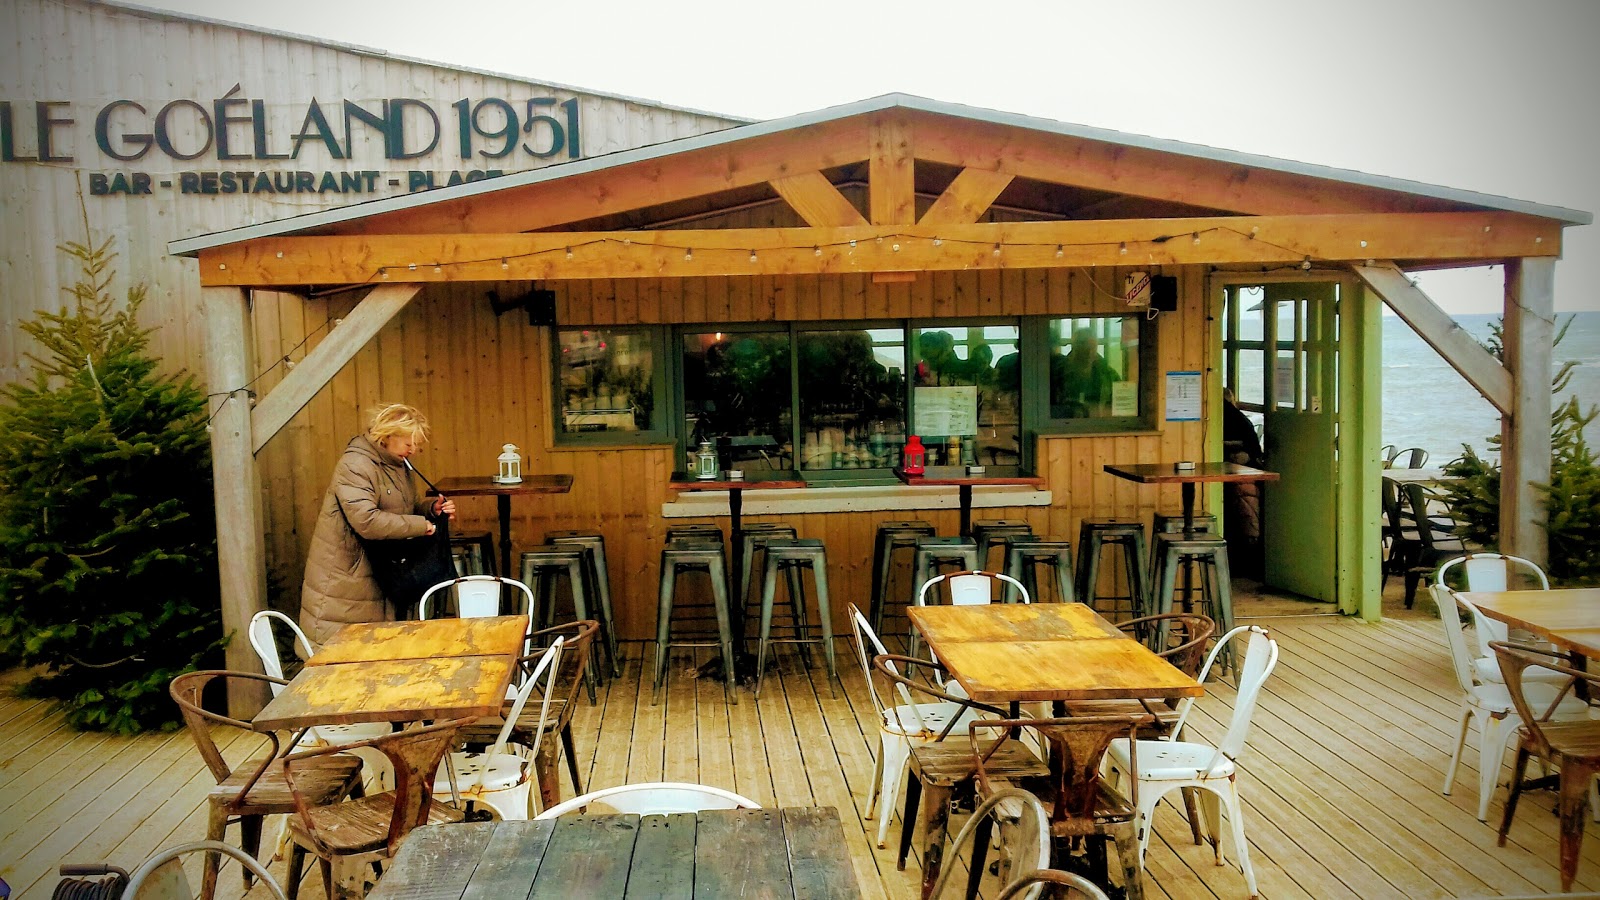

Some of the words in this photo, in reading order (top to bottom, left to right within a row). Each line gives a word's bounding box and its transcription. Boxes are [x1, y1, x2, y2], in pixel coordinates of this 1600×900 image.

[1, 101, 74, 162] LE
[95, 82, 440, 161] GOÉLAND
[452, 97, 580, 159] 1951
[90, 172, 152, 195] BAR
[180, 171, 379, 194] RESTAURANT
[1126, 273, 1150, 304] LICENC
